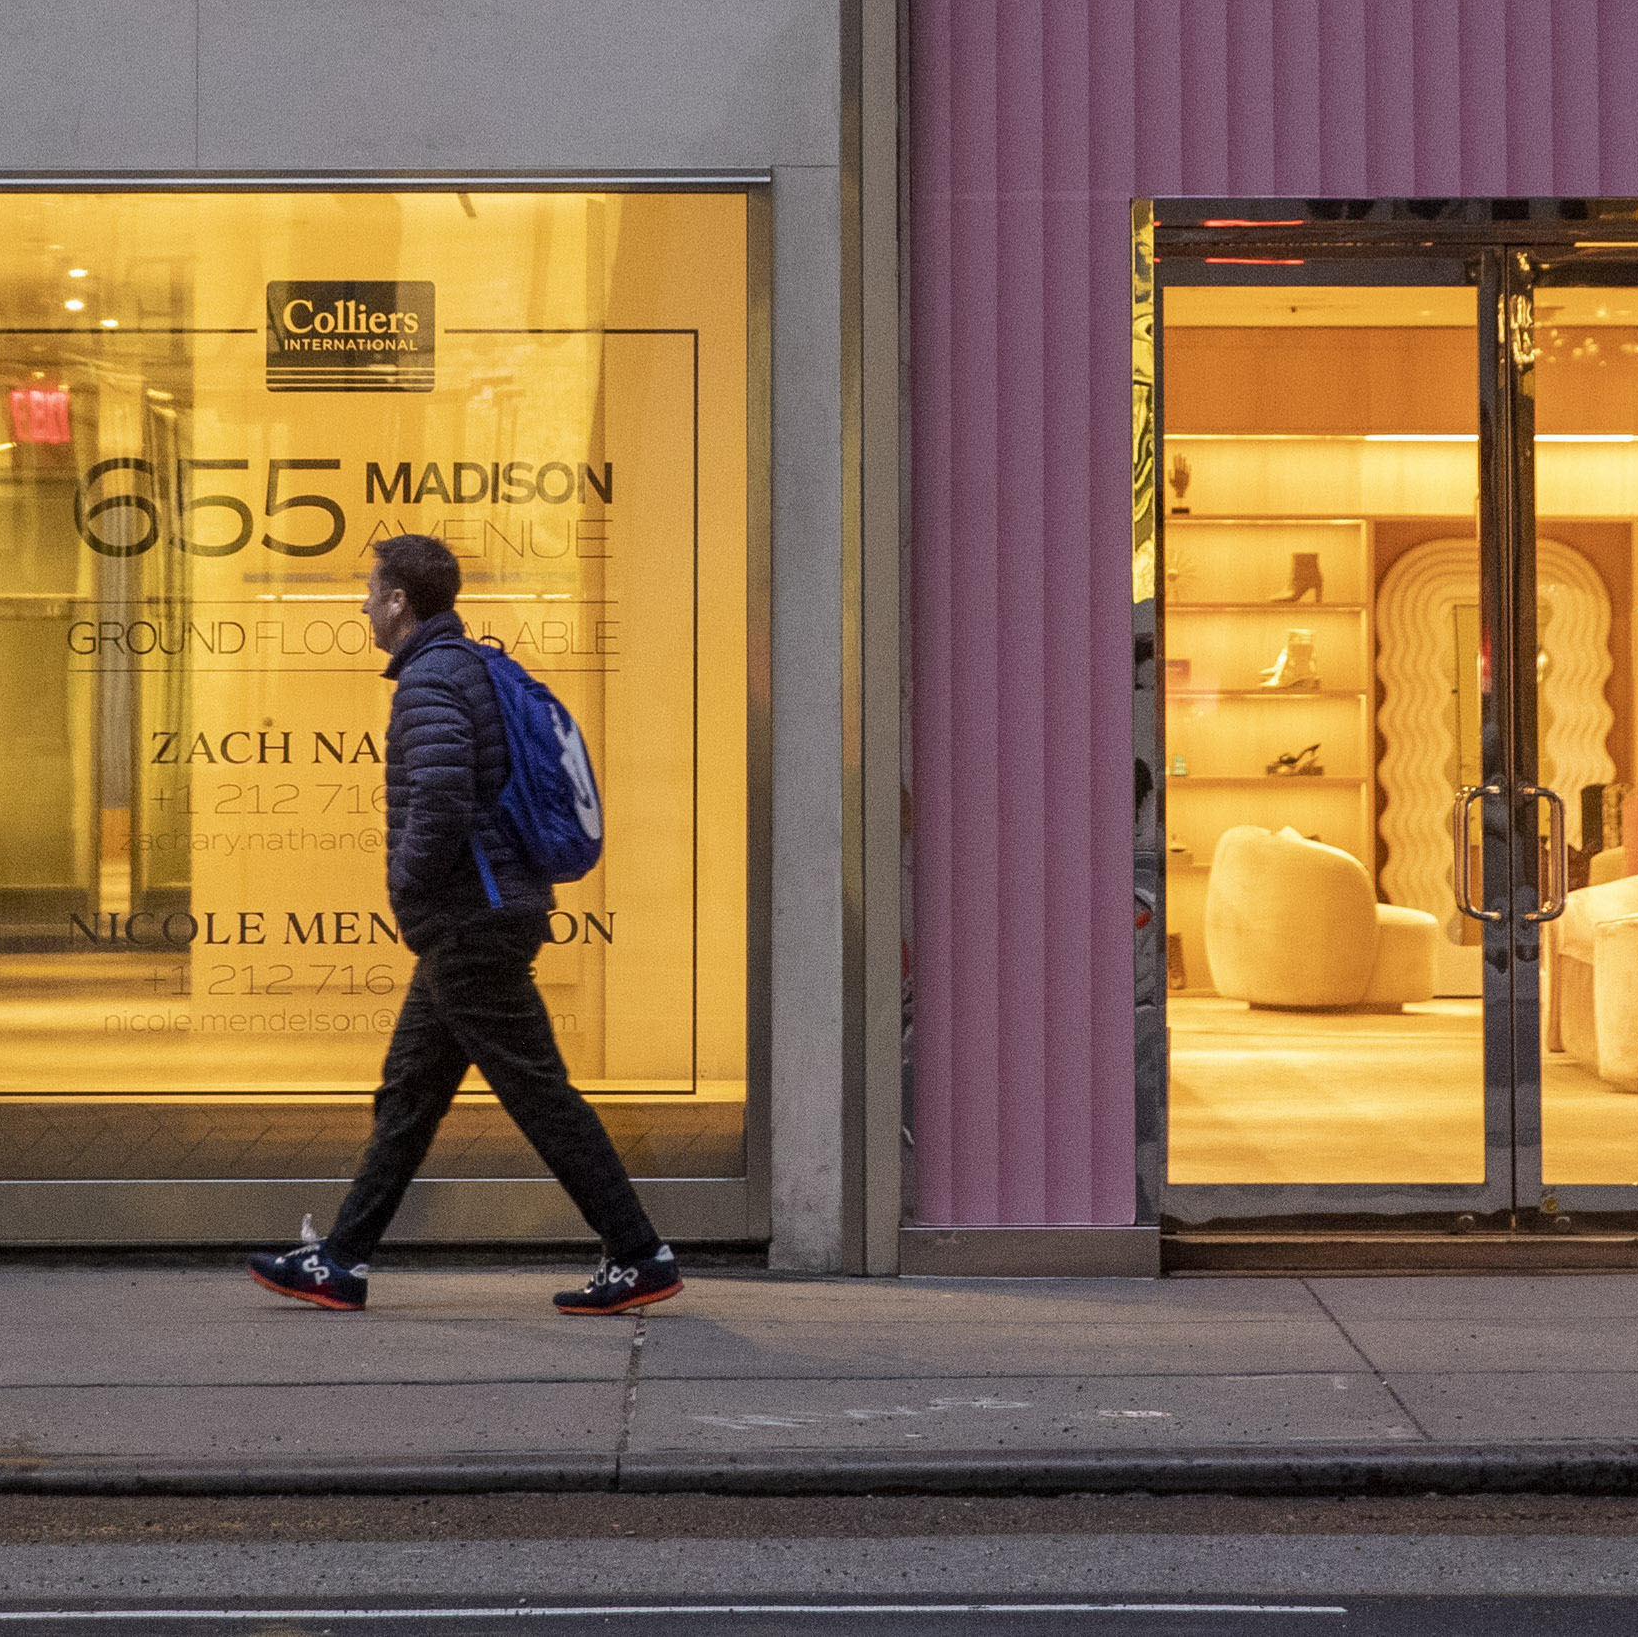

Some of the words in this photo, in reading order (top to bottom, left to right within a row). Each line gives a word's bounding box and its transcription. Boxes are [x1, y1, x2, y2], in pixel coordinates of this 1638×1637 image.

[283, 299, 419, 334] Colliers
[285, 338, 418, 351] INTERNATIONAL
[74, 457, 346, 558] 655
[366, 462, 613, 504] MADISON
[67, 621, 246, 655] GROUND
[151, 732, 293, 764] ZACH
[151, 784, 198, 814] +1
[215, 784, 301, 814] 212
[68, 911, 266, 945] NICOLE
[144, 965, 186, 995] +1
[208, 964, 294, 995] 212
[309, 964, 395, 995] 716
